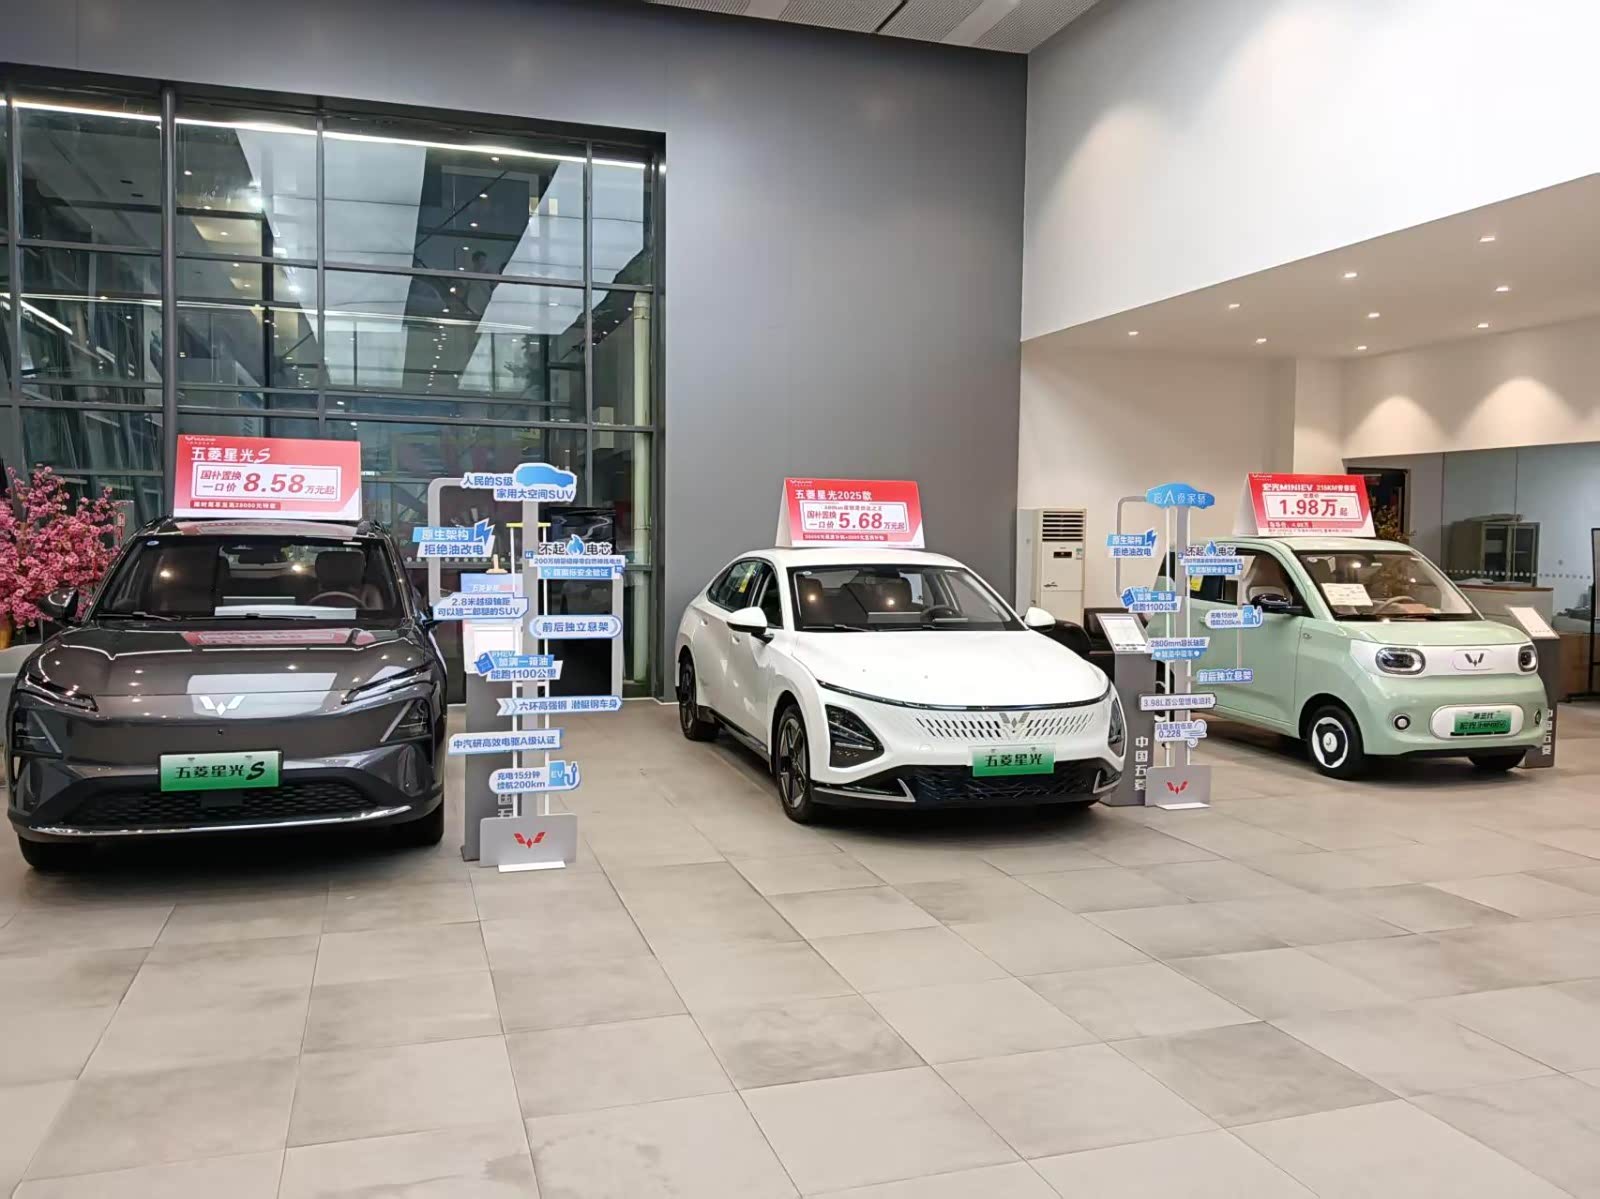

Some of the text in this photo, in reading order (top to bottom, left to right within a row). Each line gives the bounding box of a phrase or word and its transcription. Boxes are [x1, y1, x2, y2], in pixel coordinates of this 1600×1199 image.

[191, 447, 271, 464] 五菱星光S
[200, 469, 242, 481] 国补置换
[463, 475, 514, 487] 人民的S级
[202, 482, 237, 493] 一口价
[243, 473, 336, 495] 8.58 万元起
[496, 488, 574, 500] 家用大空间SUV
[795, 489, 873, 501] 五菱星光2025款
[1279, 499, 1338, 516] 1.98万
[808, 520, 835, 529] 一口价
[838, 512, 905, 530] 5.68 万元起
[421, 529, 470, 541] 原生架构
[423, 543, 485, 556] 拒绝油改电
[586, 543, 613, 555] 电芯
[542, 621, 609, 633] 前后独立悬架
[490, 668, 557, 680] 能跑1100公里
[518, 699, 618, 711] 六环高强钢 潜艇钢车身
[1158, 729, 1182, 738] 0.228
[453, 736, 557, 749] 中汽研高效电驱A级认证
[985, 753, 1043, 767] 五菱星光
[175, 761, 265, 781] 五菱星光S
[497, 771, 541, 780] 充电15分钟
[551, 770, 564, 779] EV
[497, 780, 546, 790] 续航200km
